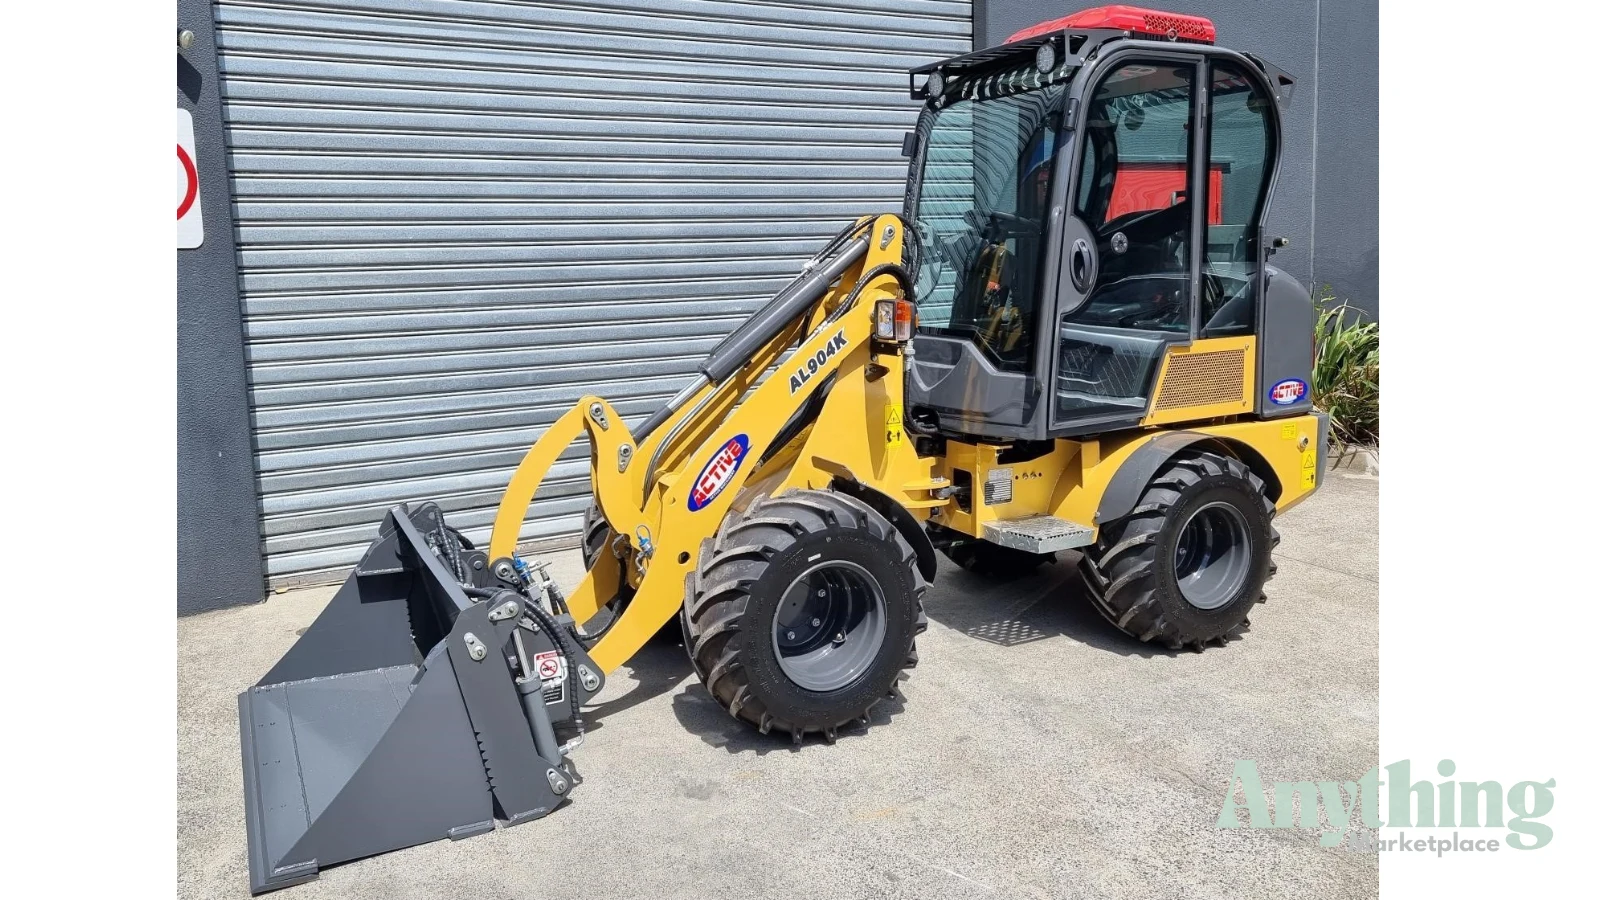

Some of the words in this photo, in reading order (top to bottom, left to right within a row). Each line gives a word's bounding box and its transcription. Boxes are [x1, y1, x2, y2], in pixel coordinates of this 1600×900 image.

[789, 330, 848, 395] AL904K
[1272, 382, 1304, 400] ACTIVE
[692, 439, 743, 508] ACTIVE
